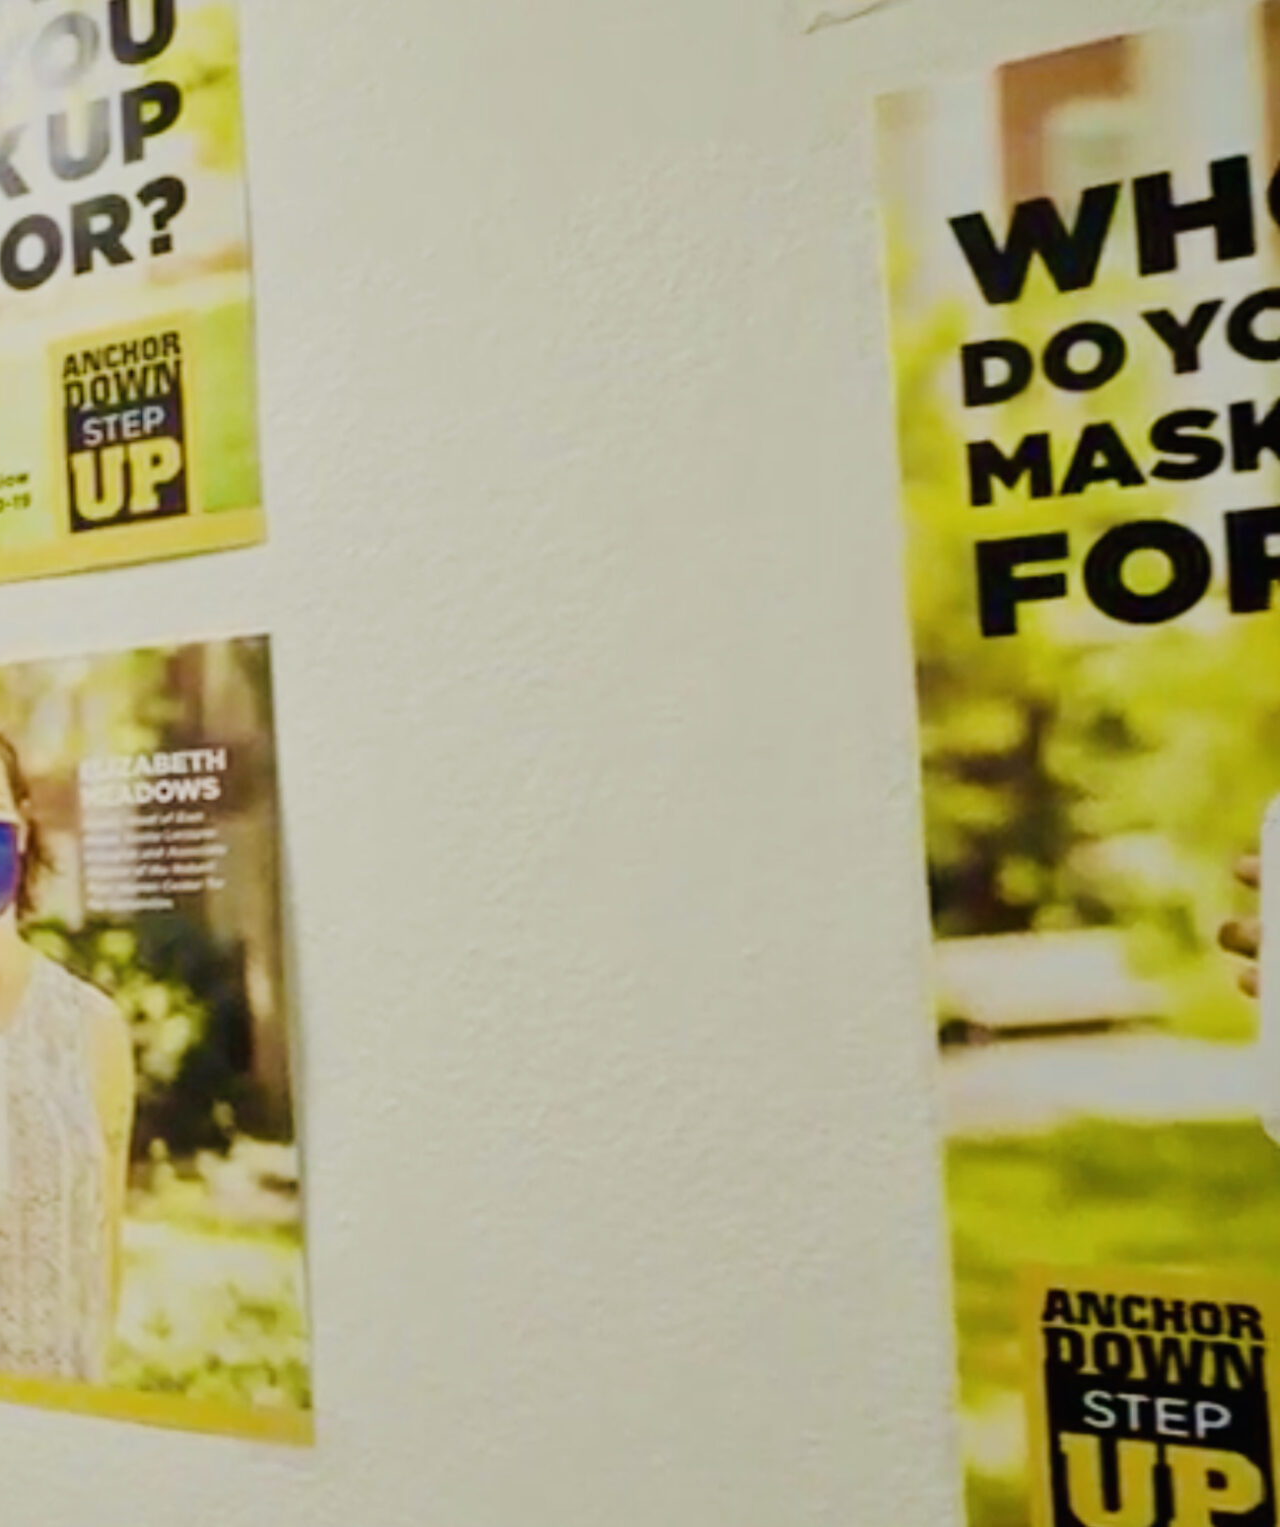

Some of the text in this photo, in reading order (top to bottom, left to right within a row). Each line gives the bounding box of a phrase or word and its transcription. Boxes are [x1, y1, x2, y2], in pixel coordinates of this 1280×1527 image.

[47, 81, 183, 181] UP
[948, 154, 1280, 306] WH
[62, 331, 182, 378] ANCHOR
[63, 359, 184, 412] DOWN
[961, 320, 1127, 409] DO
[82, 406, 166, 448] STEP
[70, 436, 183, 522] UP
[1042, 1288, 1265, 1342] ANCHOR
[1042, 1326, 1266, 1391] DOWN
[1082, 1390, 1232, 1439] STEP
[1058, 1431, 1268, 1527] UP
